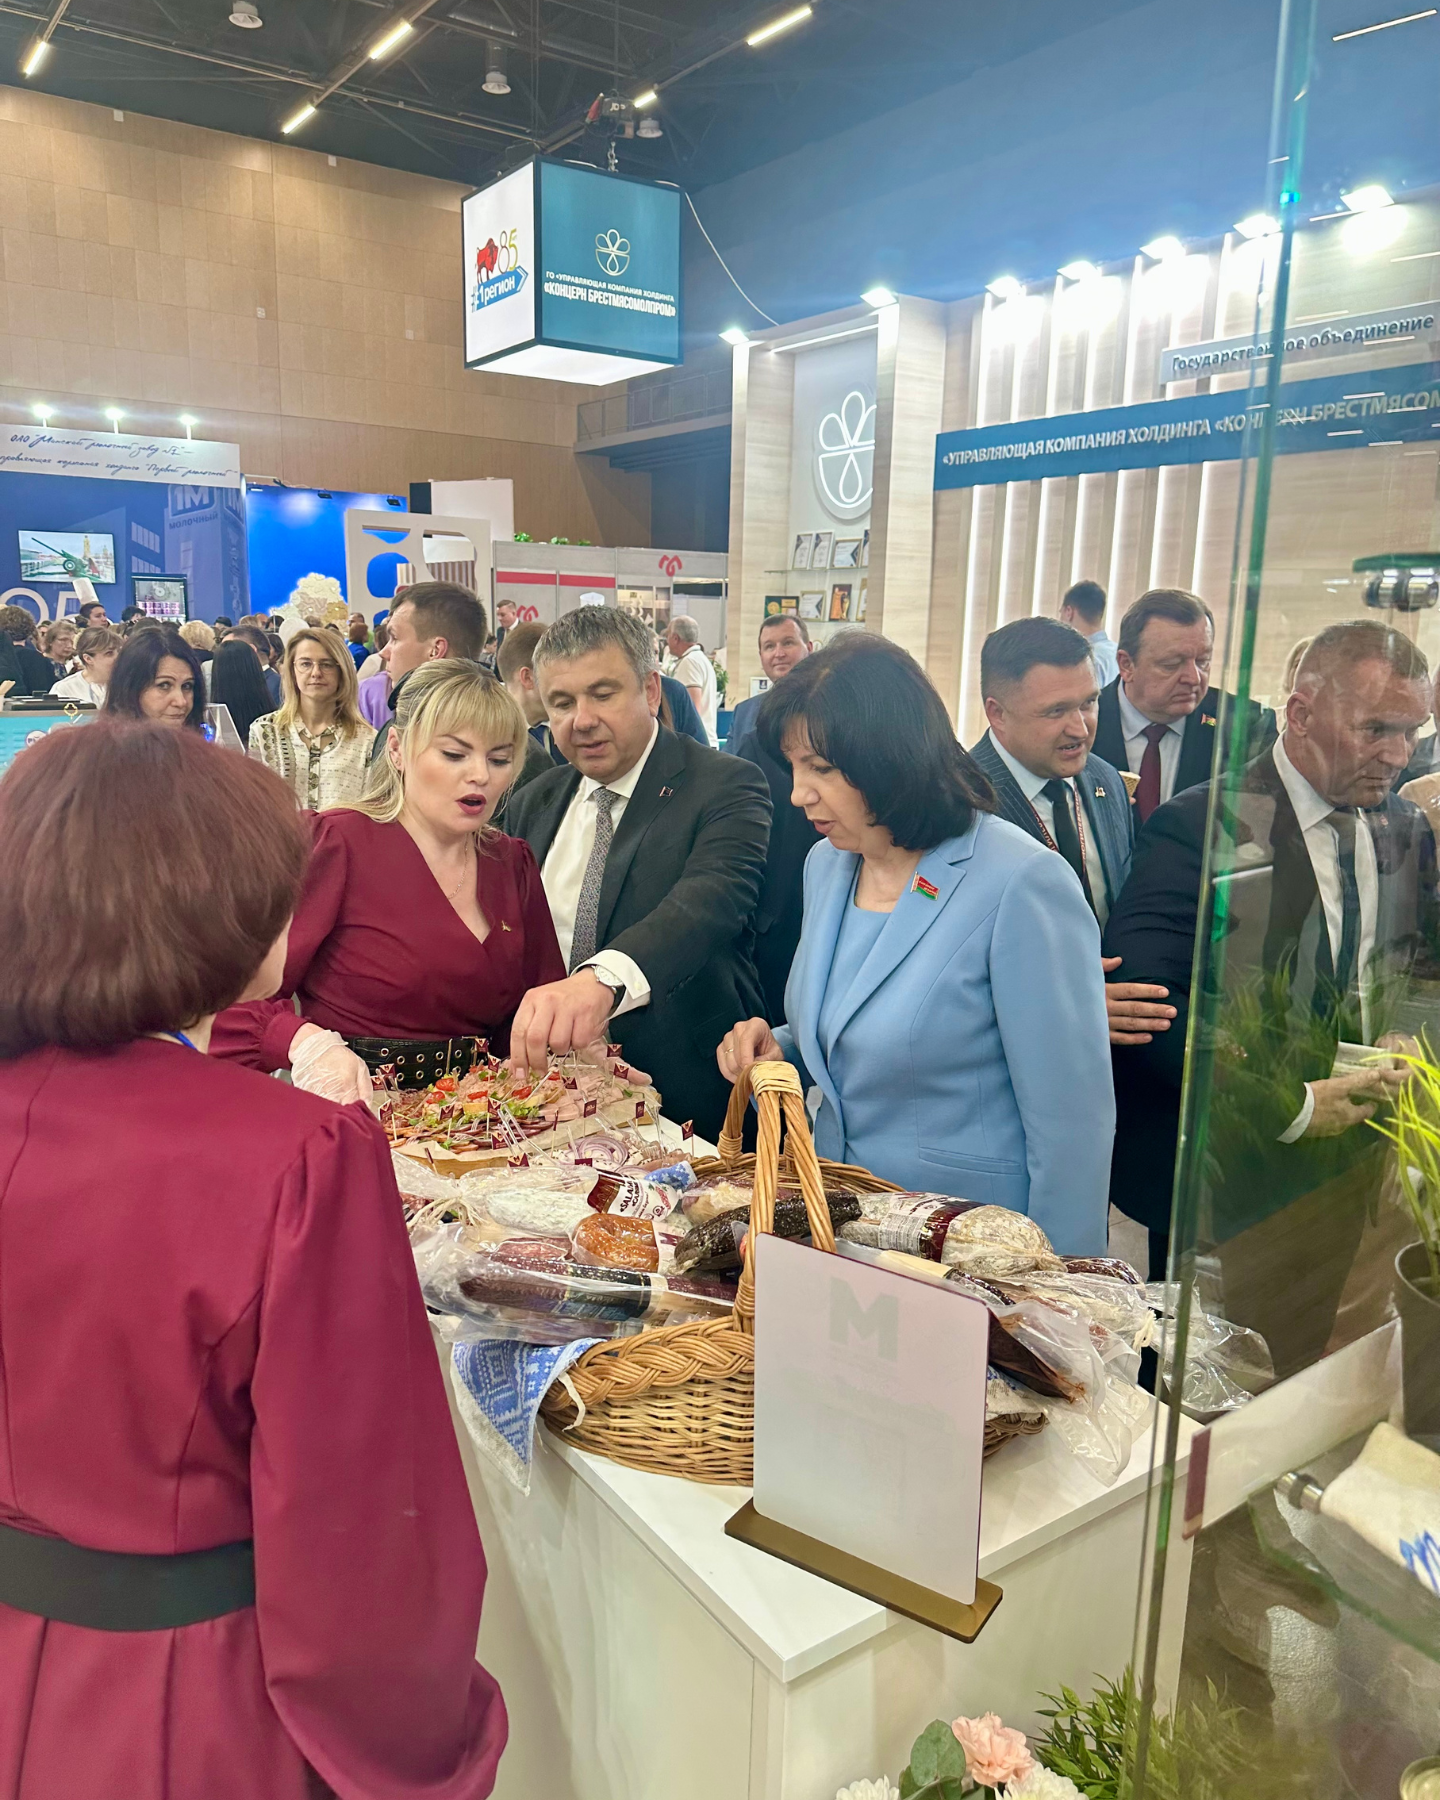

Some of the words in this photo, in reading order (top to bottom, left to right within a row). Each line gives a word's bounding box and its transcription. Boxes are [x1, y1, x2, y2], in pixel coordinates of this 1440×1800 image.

[471, 275, 516, 313] #1регион
[544, 281, 587, 301] «КОНЦЕРН
[588, 288, 676, 317] БРЕСТМЯСОМОЛПРОМ»
[546, 271, 555, 279] ГО
[556, 273, 606, 289] «УПРАВЛЯЮЩАЯ
[607, 282, 642, 296] КОМПАНИЯ
[643, 290, 675, 302] ХОЛДИНГА
[1309, 314, 1434, 349] объединение
[10, 434, 30, 443] ОАО
[943, 439, 1047, 466] «УПРАВЛЯЮЩАЯ
[1046, 429, 1125, 453] КОМПАНИЯ
[1127, 418, 1211, 444] ХОЛДИНГА
